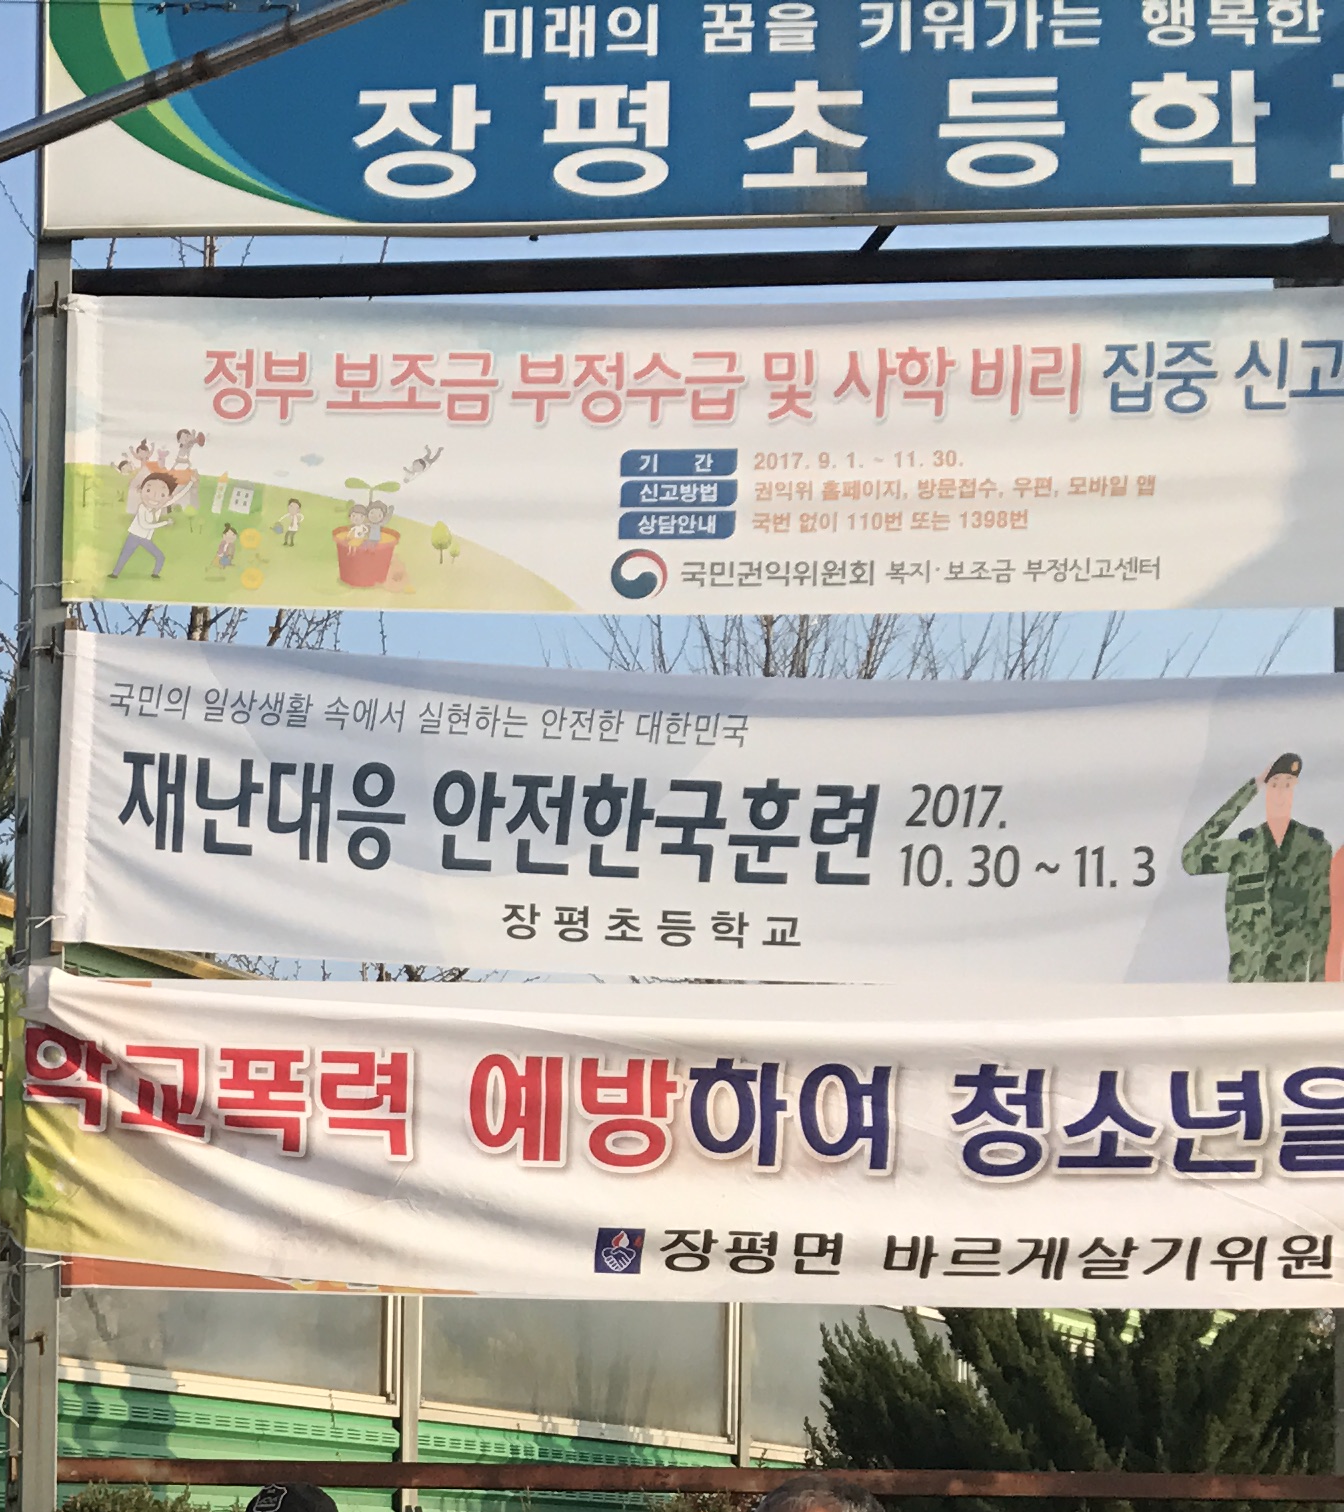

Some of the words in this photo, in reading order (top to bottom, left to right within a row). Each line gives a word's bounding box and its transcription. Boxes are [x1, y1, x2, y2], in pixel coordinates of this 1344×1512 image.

[483, 3, 658, 58] 미래의
[703, 2, 818, 53] 꿈을
[859, 0, 1102, 52] 키워가는
[1142, 0, 1324, 47] 행복한
[352, 70, 1344, 198] 장평초등학
[203, 348, 314, 422] 정부
[326, 350, 499, 423] 보조금
[512, 348, 746, 424] 부정수급
[763, 348, 814, 420] 및
[833, 345, 955, 418] 사학
[970, 342, 1081, 416] 비리
[1103, 340, 1218, 413] 집중
[1235, 337, 1344, 410] 신고
[753, 451, 810, 470] 2017.
[932, 449, 964, 467] 30.
[639, 482, 718, 502] 신고방법
[755, 480, 814, 501] 권익위
[821, 478, 908, 501] 홈페이지,
[917, 477, 1004, 499] 방문접수,
[1013, 475, 1059, 498] 우편,
[1067, 475, 1128, 497] 모바일
[1137, 474, 1156, 497] 앱
[637, 514, 716, 535] 상담안내
[752, 511, 791, 533] 국번
[799, 511, 838, 533] 없이
[847, 510, 904, 532] 110번
[911, 510, 951, 531] 또는
[961, 508, 1029, 530] 1398번
[681, 559, 876, 588] 국민권익위원회
[1022, 555, 1161, 584] 부정신고센터
[109, 682, 191, 721] 국민의
[203, 687, 314, 728] 일상생활
[324, 695, 406, 733] 속에서
[418, 701, 528, 739] 실현하는
[541, 706, 624, 743] 안전한
[635, 710, 749, 748] 대한민국
[118, 750, 406, 871] 재난대응
[432, 768, 880, 887] 안전한국훈련
[905, 783, 1008, 829] 2017.
[502, 902, 801, 949] 장평초등학교
[469, 1053, 892, 1171] 예방하여
[952, 1063, 1344, 1178] 청소년을
[660, 1228, 844, 1276] 장평면
[883, 1234, 1333, 1281] 바르게살기위원
